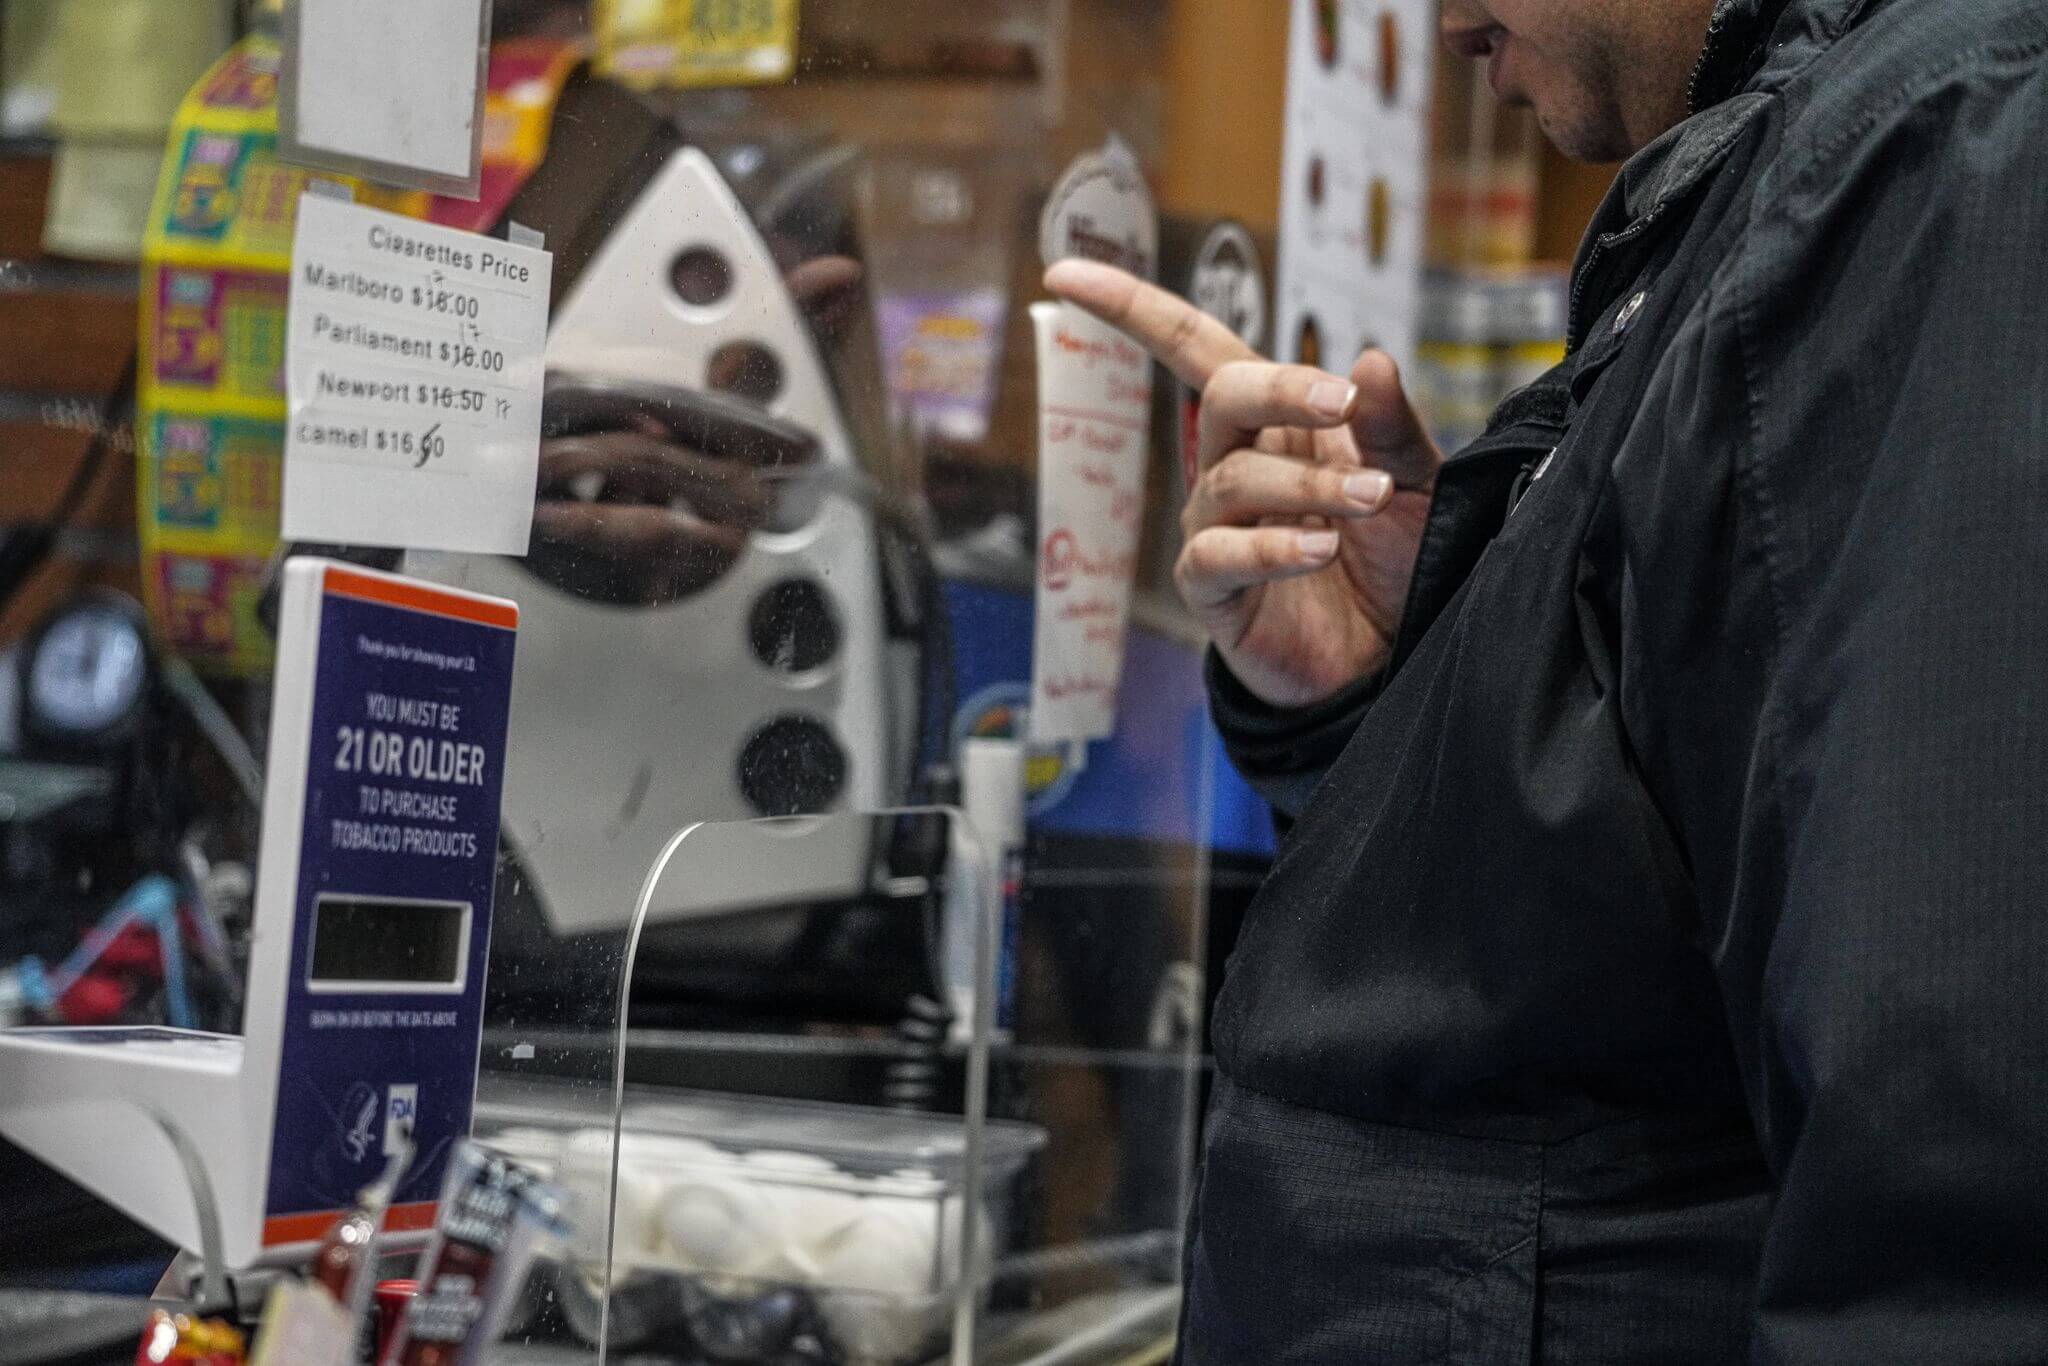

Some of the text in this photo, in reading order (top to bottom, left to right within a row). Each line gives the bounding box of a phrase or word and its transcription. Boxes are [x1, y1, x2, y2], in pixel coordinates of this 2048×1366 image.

[305, 260, 403, 303] Marlboro
[480, 252, 529, 283] Price
[313, 311, 432, 360] Parliament
[317, 370, 485, 412] Newport $16.50
[297, 421, 368, 450] Camel
[366, 692, 460, 732] YOU MUST BE
[334, 725, 485, 787] 21 OR OLDER
[360, 784, 458, 823] TO PURCHASE
[331, 818, 479, 858] TOBACCO PRODUCTS
[397, 1010, 409, 1027] THE
[433, 1011, 458, 1027] ABOVE
[391, 1097, 416, 1119] FDA
